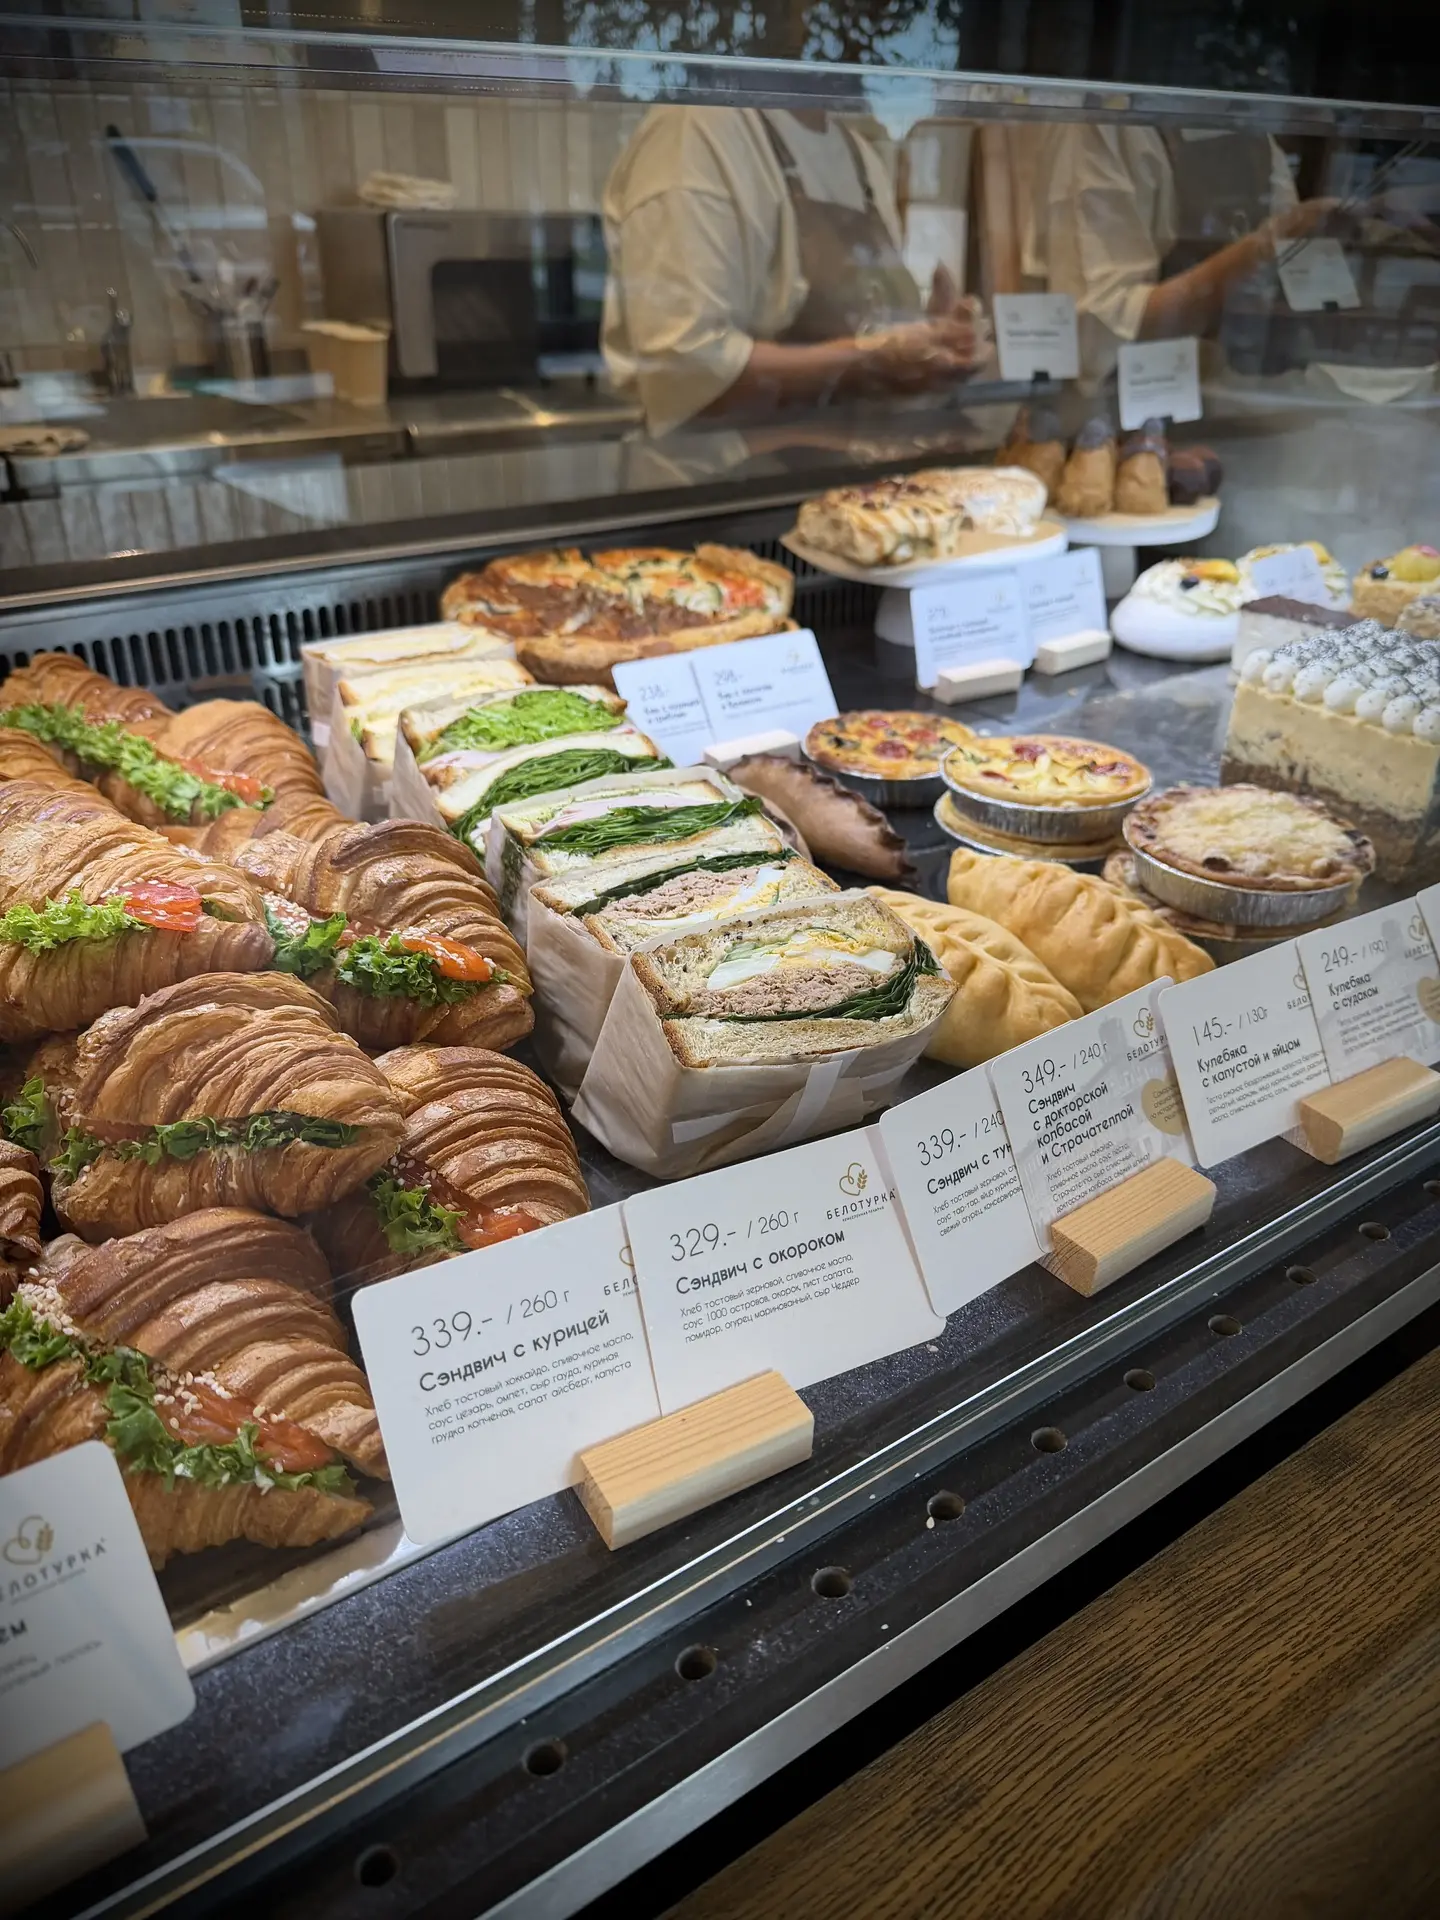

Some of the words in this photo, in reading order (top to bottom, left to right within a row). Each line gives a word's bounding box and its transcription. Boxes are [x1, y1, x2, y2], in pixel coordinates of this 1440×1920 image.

[1320, 946, 1358, 973] 249.-
[1328, 973, 1372, 997] Кулебяка
[1333, 1001, 1340, 1011] с
[1342, 986, 1379, 1008] судаком
[1192, 1017, 1232, 1047] 145.-
[1021, 1059, 1066, 1094] 349.-
[1079, 1043, 1101, 1065] 240
[1103, 1043, 1107, 1053] г
[1197, 1044, 1247, 1073] Кулебяка
[1202, 1078, 1209, 1088] с
[1211, 1053, 1261, 1084] капустой
[1263, 1052, 1270, 1062] и
[1272, 1038, 1301, 1059] яйцом
[1028, 1083, 1076, 1114] Сэндвич
[1033, 1121, 1041, 1131] с
[1045, 1082, 1109, 1129] докторской
[917, 1128, 966, 1166] 339.-
[974, 1122, 978, 1139] /
[981, 1110, 1005, 1134] 240
[1037, 1109, 1093, 1148] колбасой
[1041, 1153, 1050, 1165] и
[1051, 1103, 1135, 1157] Страчателлой
[927, 1159, 980, 1195] Сэндвич
[981, 1154, 990, 1165] с
[932, 1200, 949, 1214] Хлеб
[950, 1184, 979, 1204] тостовый
[826, 1190, 896, 1220] БЕЛОТУРКА
[936, 1213, 952, 1226] соус
[669, 1223, 736, 1262] 329.-
[747, 1220, 752, 1238] /
[758, 1210, 789, 1234] 260
[793, 1211, 799, 1223] г
[676, 1262, 747, 1294] Сэндвич
[752, 1257, 763, 1269] с
[768, 1230, 845, 1264] окороком
[680, 1302, 703, 1317] Хлеб
[704, 1290, 744, 1309] тостовый
[746, 1276, 784, 1295] зерновой,
[785, 1262, 826, 1282] сливочное
[827, 1254, 854, 1268] масло,
[411, 1311, 493, 1356] 339.-
[507, 1304, 512, 1324] /
[520, 1290, 558, 1318] 260
[563, 1290, 570, 1302] г
[683, 1317, 703, 1330] соус
[706, 1307, 728, 1322] 1000
[803, 1277, 820, 1289] лист
[822, 1267, 854, 1282] салата,
[685, 1326, 723, 1344] помидор,
[724, 1314, 753, 1330] огурец
[813, 1287, 831, 1298] сыр
[831, 1277, 860, 1291] Чеддер
[419, 1351, 507, 1391] Сэндвич
[513, 1344, 526, 1357] с
[532, 1309, 610, 1351] курицей
[424, 1398, 452, 1417] Хлеб
[454, 1381, 503, 1405] тостовый
[504, 1364, 550, 1387] хоккайдо,
[552, 1345, 601, 1369] сливочное
[602, 1332, 634, 1348] масло,
[428, 1416, 454, 1431] соус
[455, 1402, 495, 1421] цезарь,
[496, 1387, 528, 1405] омлет,
[530, 1378, 551, 1392] сыр
[552, 1367, 582, 1383] гауда,
[583, 1352, 619, 1371] куриная
[431, 1426, 465, 1445] грудка
[467, 1407, 516, 1431] копченая,
[517, 1393, 548, 1411] салат
[551, 1377, 593, 1398] айсберг,
[594, 1361, 632, 1381] капуста
